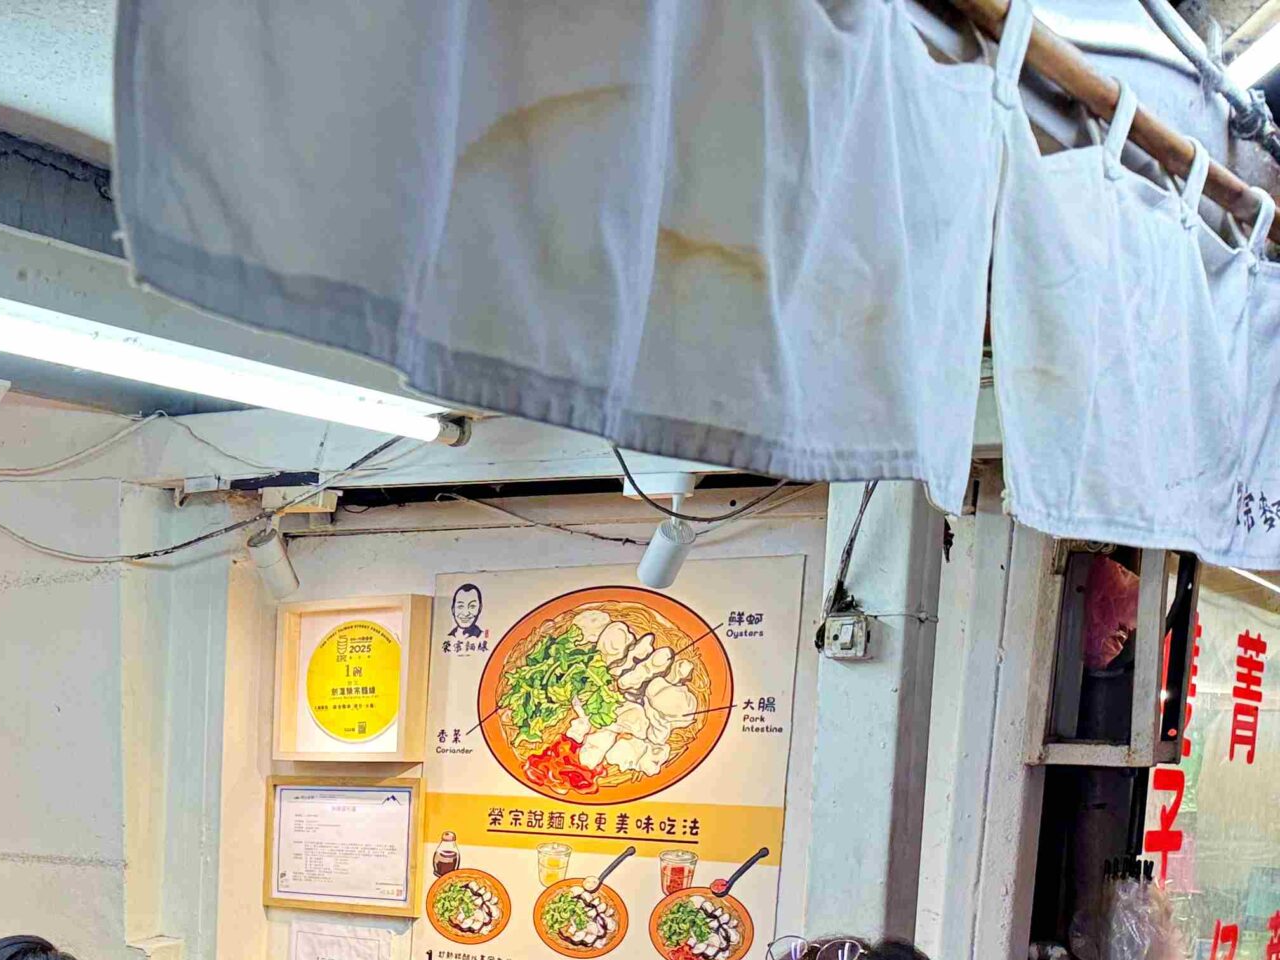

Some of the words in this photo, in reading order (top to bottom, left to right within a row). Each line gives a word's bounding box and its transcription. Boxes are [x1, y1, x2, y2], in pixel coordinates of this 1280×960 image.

[728, 611, 763, 627] 鮮蚵
[726, 628, 764, 638] Oysters
[349, 644, 372, 654] 2025
[742, 696, 776, 713] 大腸
[743, 714, 765, 723] Pork
[741, 723, 784, 734] Intestine
[437, 728, 462, 744] 香菜
[435, 746, 474, 755] Coriander
[487, 808, 701, 837] 榮宗說麵線更美味吃法
